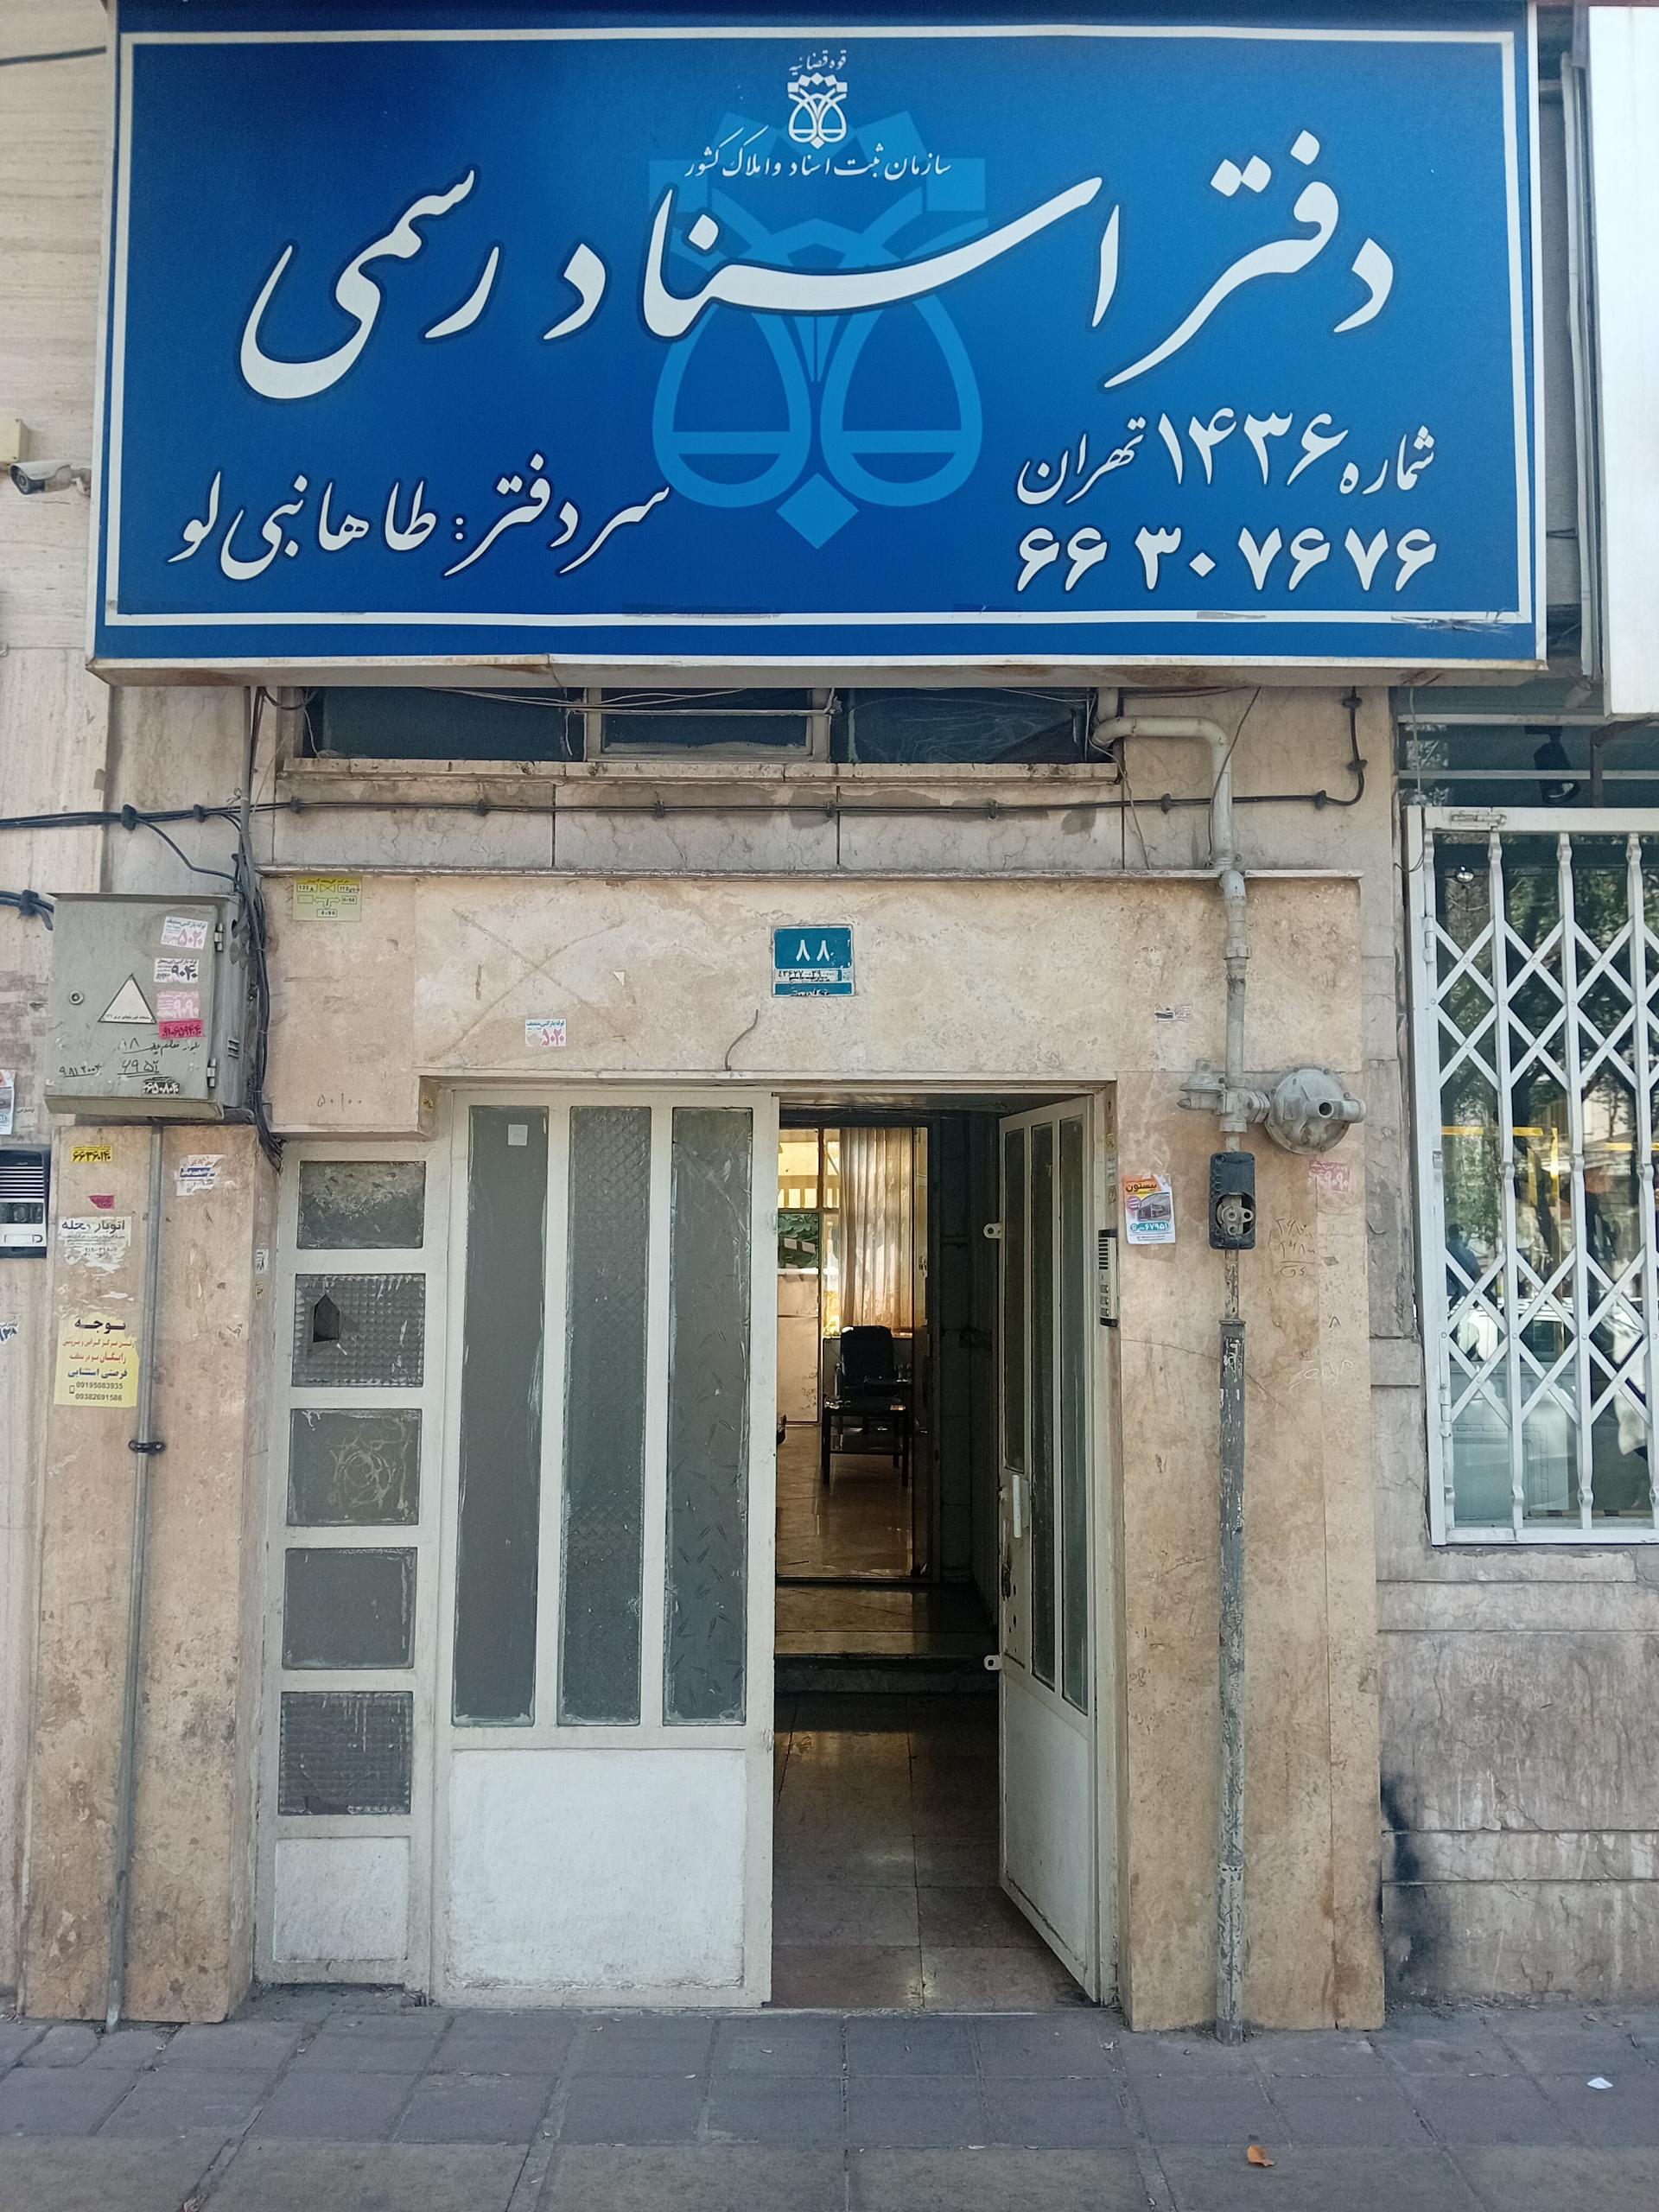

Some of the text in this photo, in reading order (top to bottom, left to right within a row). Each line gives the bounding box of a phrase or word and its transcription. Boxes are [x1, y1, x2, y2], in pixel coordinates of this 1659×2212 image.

[829, 49, 847, 70] قوه
[684, 126, 745, 177] کشور
[788, 154, 831, 176] اسناد
[834, 143, 884, 178] ثبت
[884, 153, 951, 181] سازمان
[239, 130, 1395, 400] دفتر اسناد رسمی
[1015, 406, 1436, 505] شماره ۱۴۳۶ تهران
[796, 939, 830, 962] ۸۸
[94, 1219, 125, 1235] اتوبار
